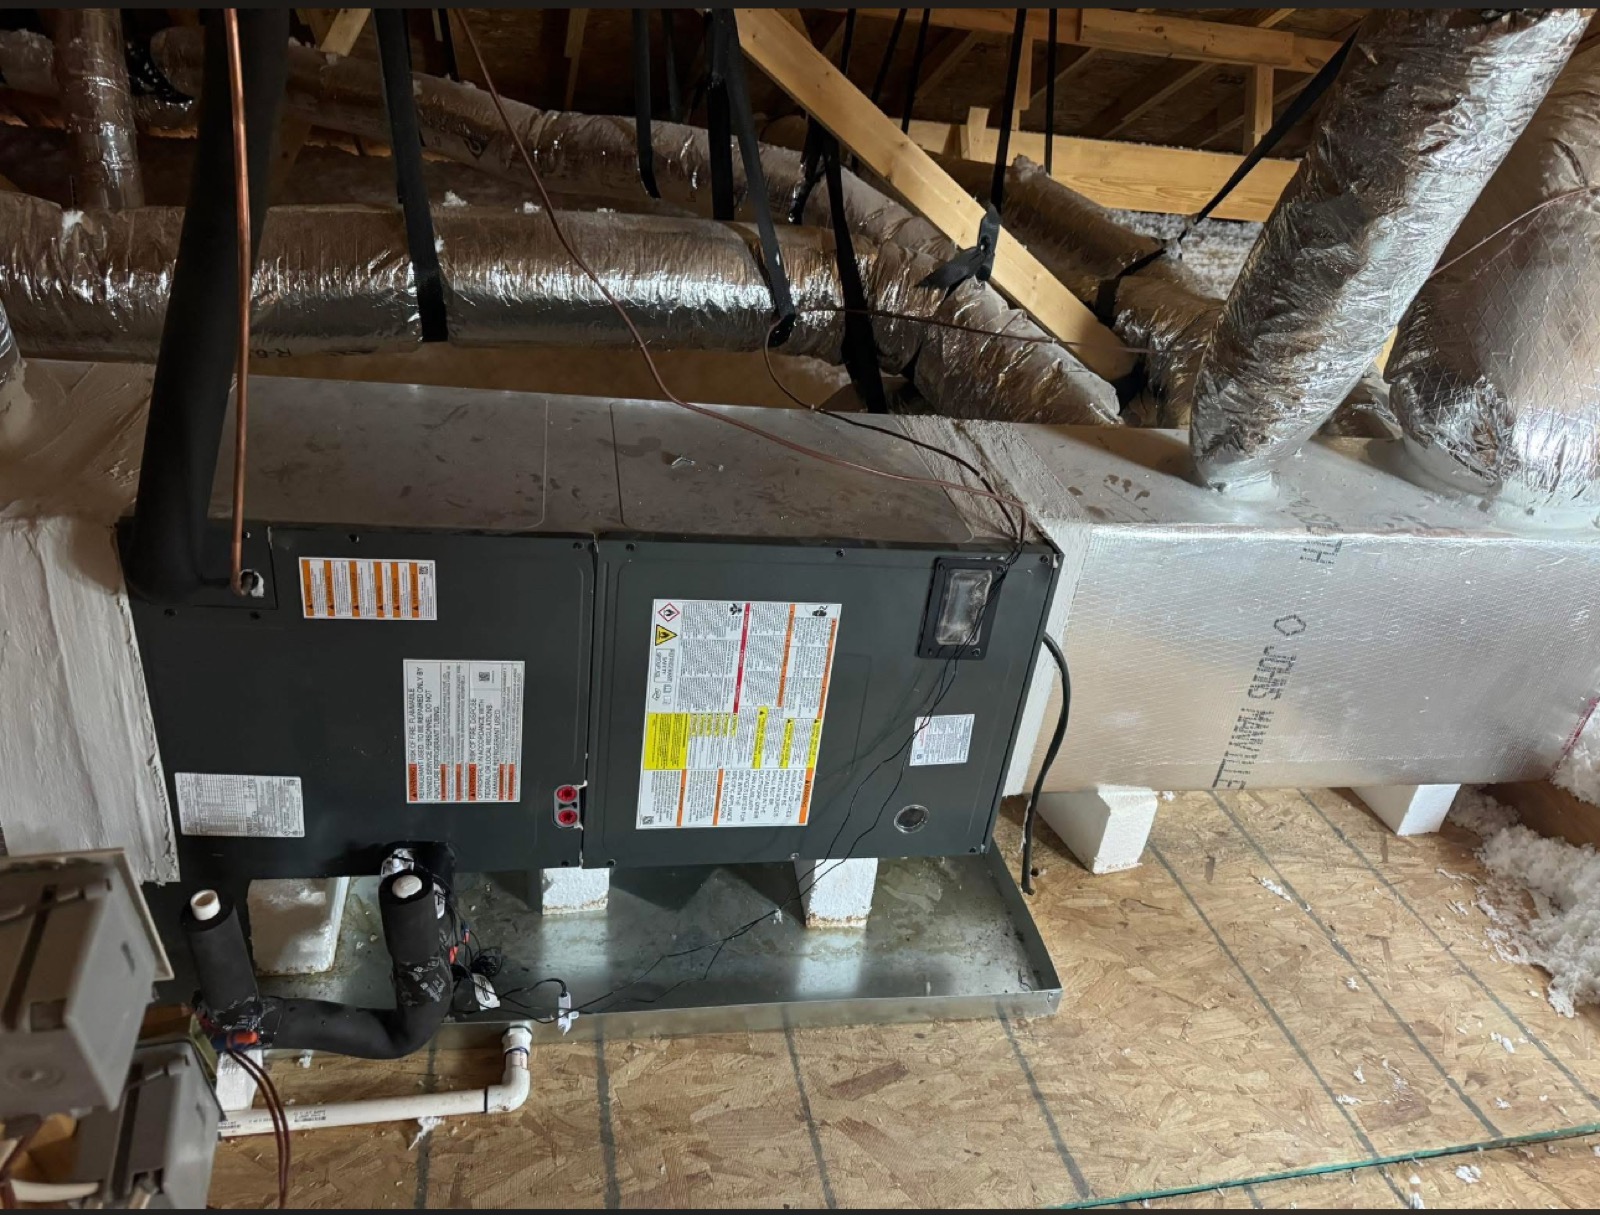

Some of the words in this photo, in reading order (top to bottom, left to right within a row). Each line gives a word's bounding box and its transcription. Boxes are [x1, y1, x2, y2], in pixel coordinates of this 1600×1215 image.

[415, 666, 422, 675] BY
[1248, 646, 1296, 700] JOHNS
[415, 676, 423, 693] ONLY
[407, 688, 415, 723] FLAMMABLE
[424, 703, 432, 712] DO
[468, 750, 476, 761] RISK
[492, 727, 500, 765] REFRIGERANT
[425, 751, 433, 774] SERVICE
[484, 765, 491, 773] OR
[417, 761, 425, 798] REFRIGERANT
[491, 766, 499, 798] FLAMMABLE
[729, 770, 737, 793] SPECIFIC
[762, 770, 770, 796] INSTALLED
[785, 796, 793, 817] DEVICES
[801, 784, 809, 807] WARNING
